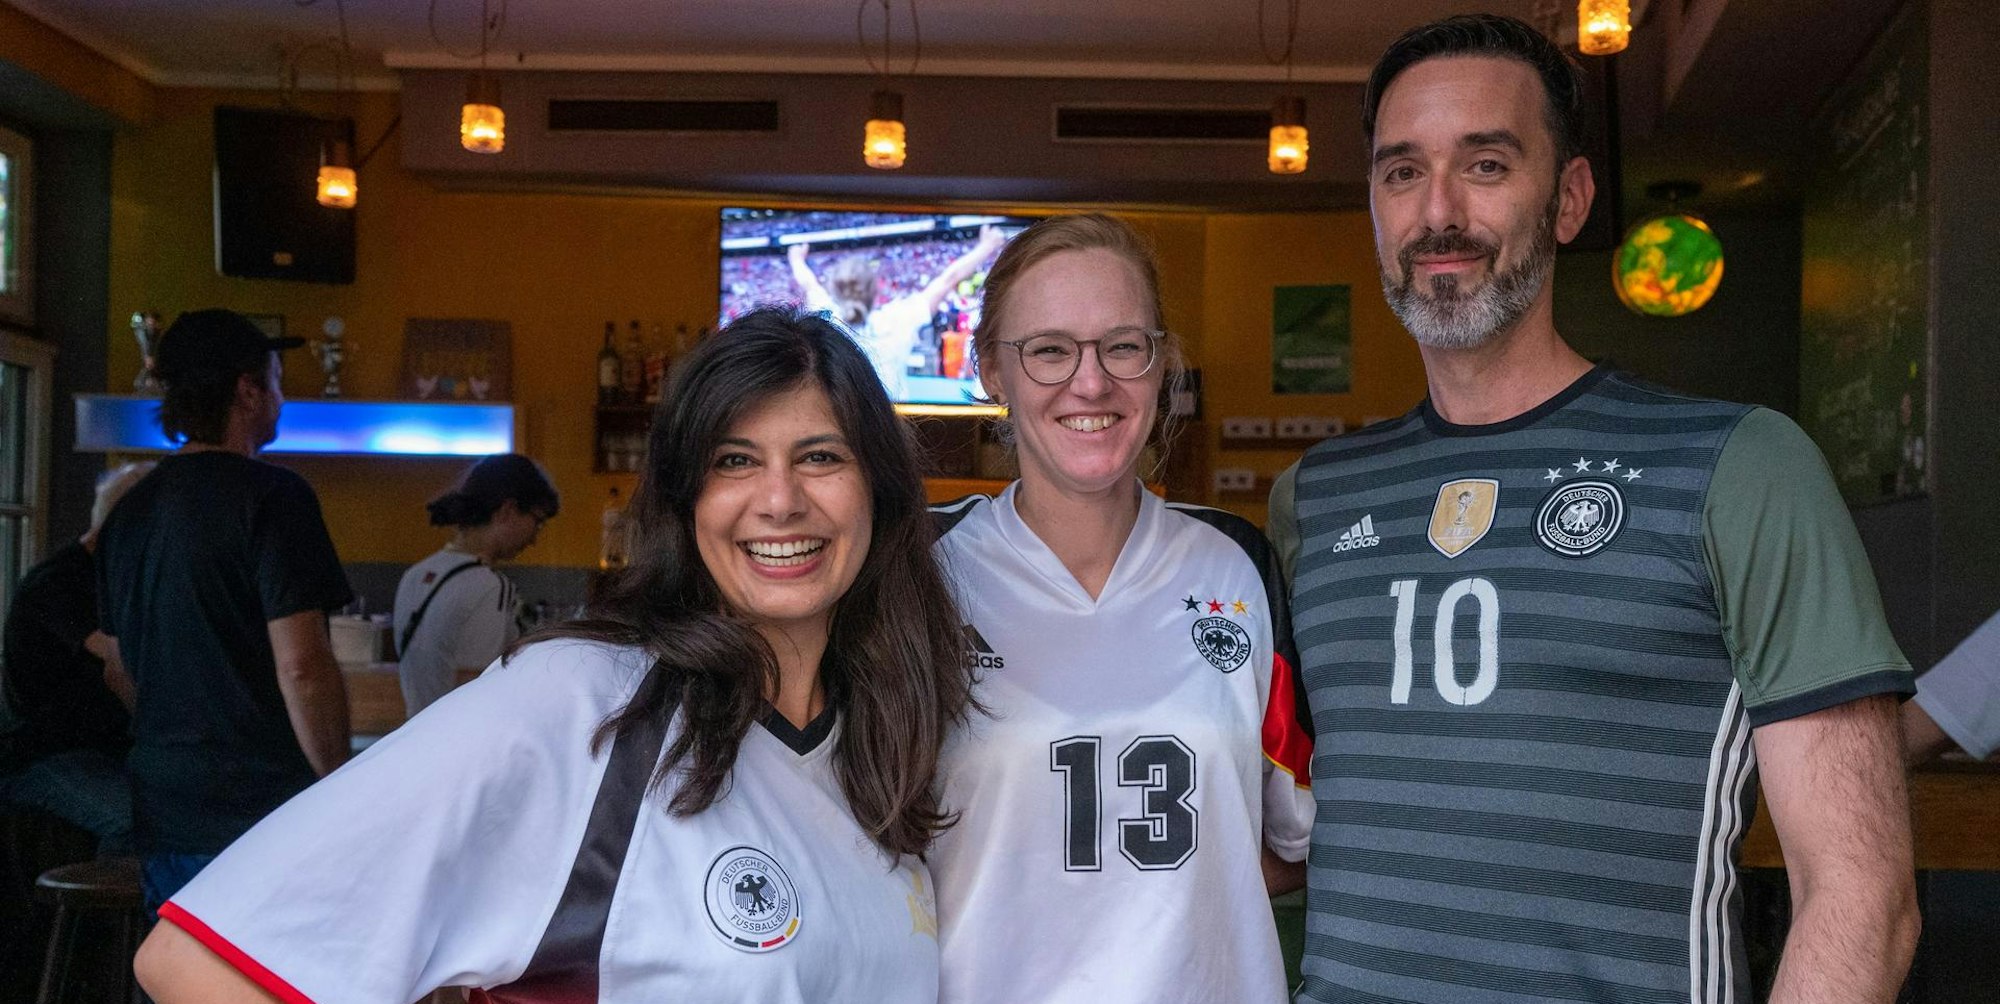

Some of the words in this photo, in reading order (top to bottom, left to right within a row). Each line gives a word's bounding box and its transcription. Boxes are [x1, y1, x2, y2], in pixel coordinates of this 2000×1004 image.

[1562, 489, 1610, 503] DEUTSCHER
[1333, 534, 1380, 553] adidas
[1389, 577, 1500, 706] 10
[1050, 734, 1199, 872] 13
[721, 859, 769, 885] DEUTSCHER
